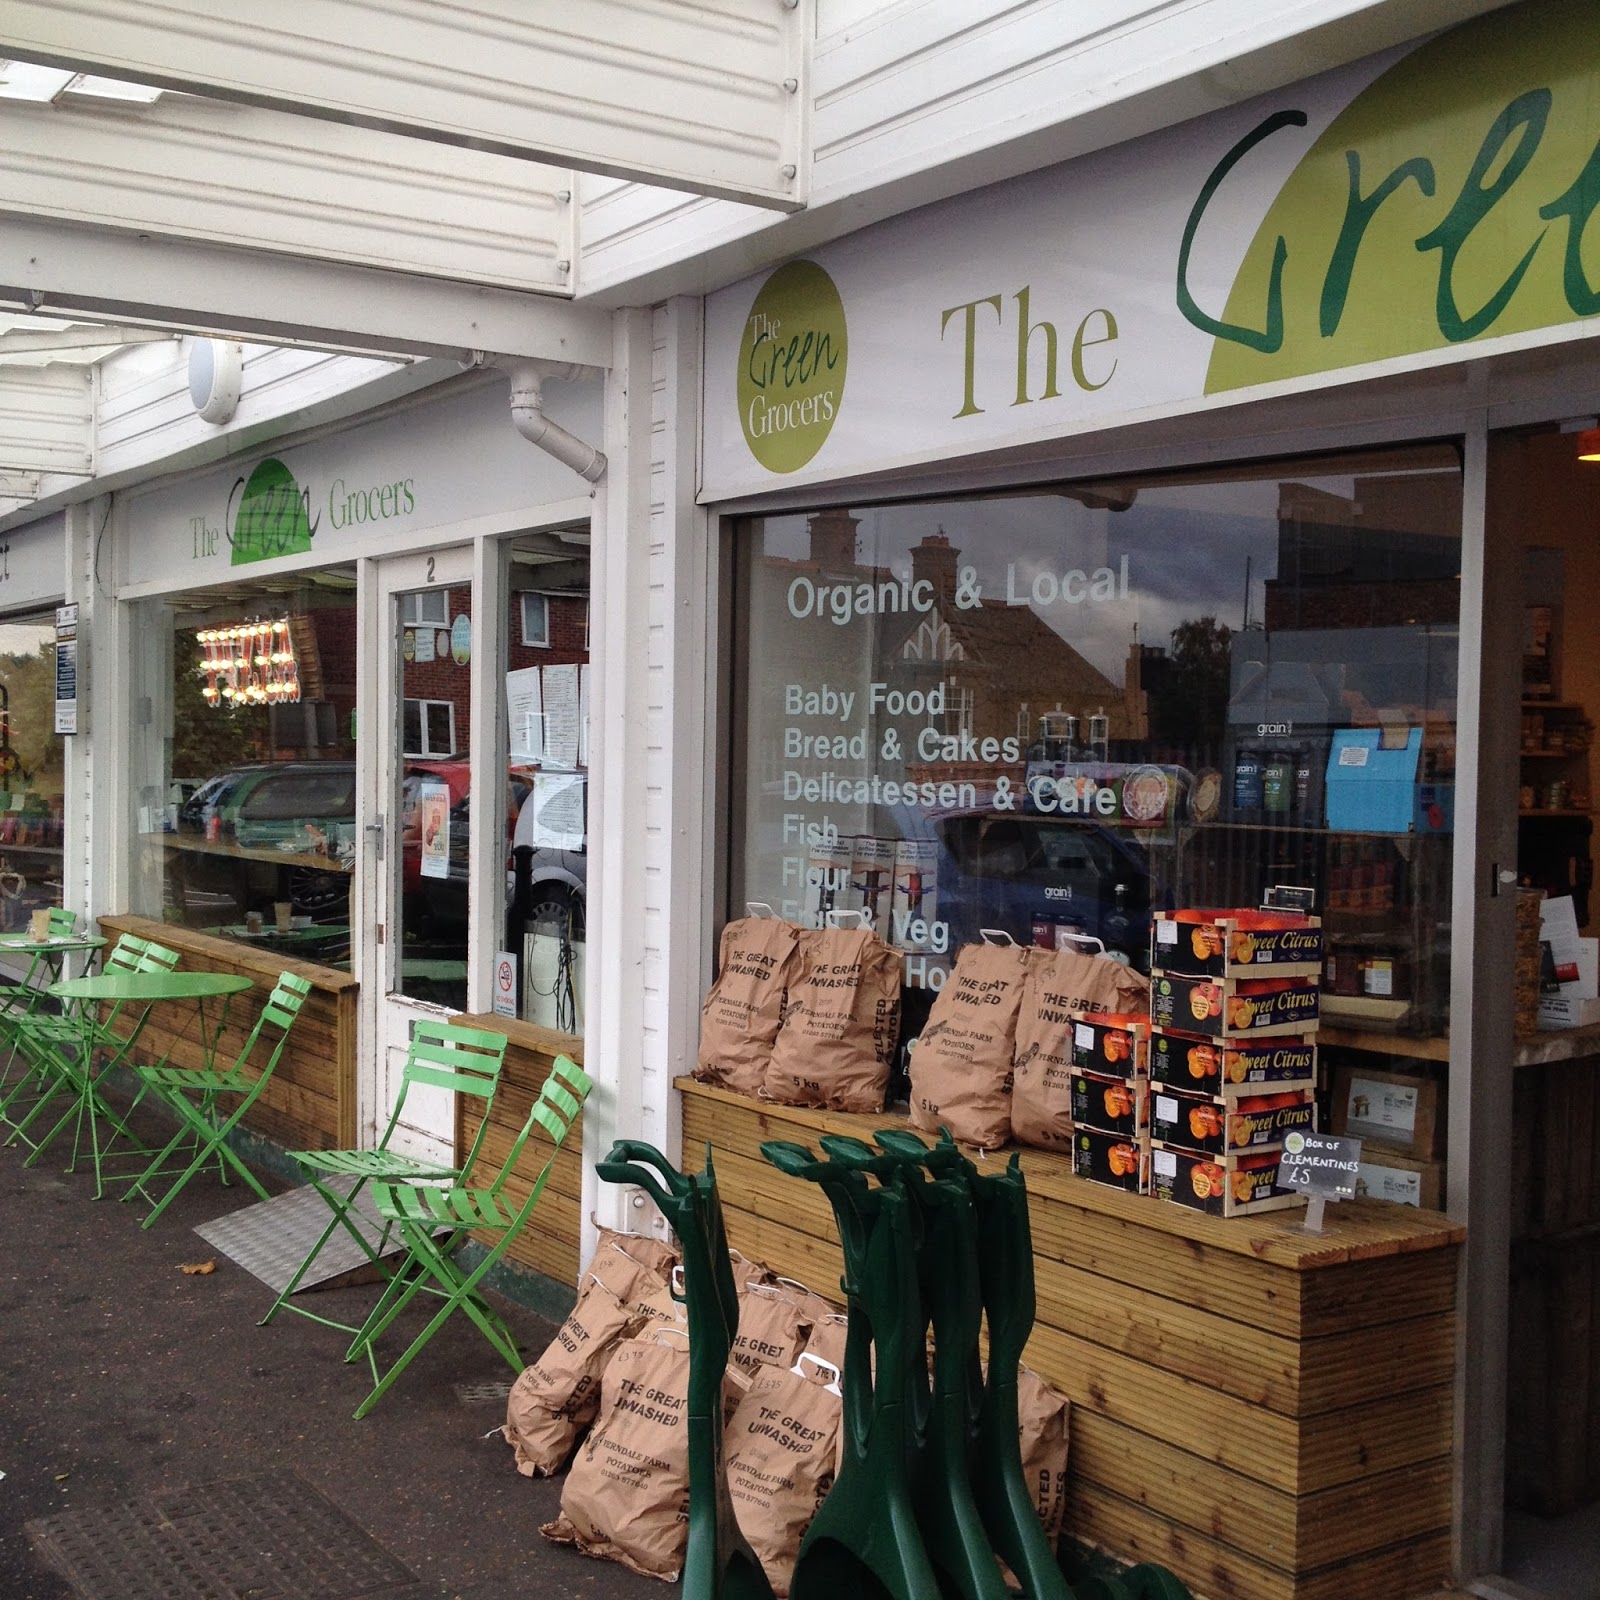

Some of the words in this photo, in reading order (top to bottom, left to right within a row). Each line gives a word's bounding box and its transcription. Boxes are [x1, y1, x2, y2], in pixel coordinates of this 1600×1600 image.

[751, 312, 781, 346] The
[750, 330, 839, 389] Green
[941, 284, 1119, 420] The
[749, 391, 834, 438] Grocers
[189, 516, 219, 559] The
[226, 476, 321, 556] Green
[330, 478, 415, 530] Grocers
[426, 556, 436, 583] 2
[787, 569, 934, 626] Organic
[955, 565, 983, 610] &
[1007, 554, 1130, 606] Local
[785, 684, 855, 721] Baby
[869, 682, 946, 715] Food
[1257, 722, 1286, 737] grain
[784, 728, 867, 760] Bread
[881, 728, 902, 761] &
[917, 727, 1020, 763] Cakes
[783, 771, 976, 809] Delicatessen
[992, 775, 1016, 811] &
[1033, 776, 1117, 815] Cafe
[783, 813, 838, 845] Fish
[782, 857, 851, 892] Flour
[1045, 886, 1068, 899] grain
[892, 908, 949, 954] Veg
[1247, 933, 1279, 950] Sweet
[1280, 931, 1320, 949] Citrus
[732, 950, 745, 960] THE
[905, 956, 954, 992] Ho
[979, 980, 1008, 992] GAT
[952, 991, 1001, 1006] NWAED
[1043, 992, 1069, 1008] THE
[1070, 998, 1110, 1014] GREA
[1245, 997, 1276, 1015] Sweet
[1277, 991, 1316, 1010] Citrus
[806, 1020, 845, 1031] POTATOES
[837, 1011, 857, 1022] FAR
[1037, 1008, 1072, 1023] UNWA
[969, 1031, 993, 1044] FARM
[1239, 1052, 1271, 1069] Sweet
[1273, 1050, 1311, 1069] Citrus
[803, 1078, 821, 1091] kg
[1046, 1068, 1071, 1079] POTA
[1244, 1115, 1274, 1132] Sweet
[1276, 1109, 1311, 1127] Citrus
[1281, 1152, 1360, 1173] CLEMENTINES
[1245, 1169, 1275, 1186] Sweet
[1288, 1167, 1312, 1185] £5
[558, 1331, 577, 1353] SHED
[734, 1335, 748, 1347] HE
[749, 1339, 785, 1358] GRET
[525, 1373, 541, 1390] TOES
[646, 1388, 687, 1410] GREAT
[781, 1416, 826, 1441] GREAT
[605, 1456, 652, 1478] POTATOES
[643, 1454, 671, 1472] FARM
[733, 1461, 772, 1482] FERNDALE
[771, 1475, 795, 1490] FARM
[735, 1477, 775, 1496] POTATOES
[1038, 1468, 1051, 1520] CTED
